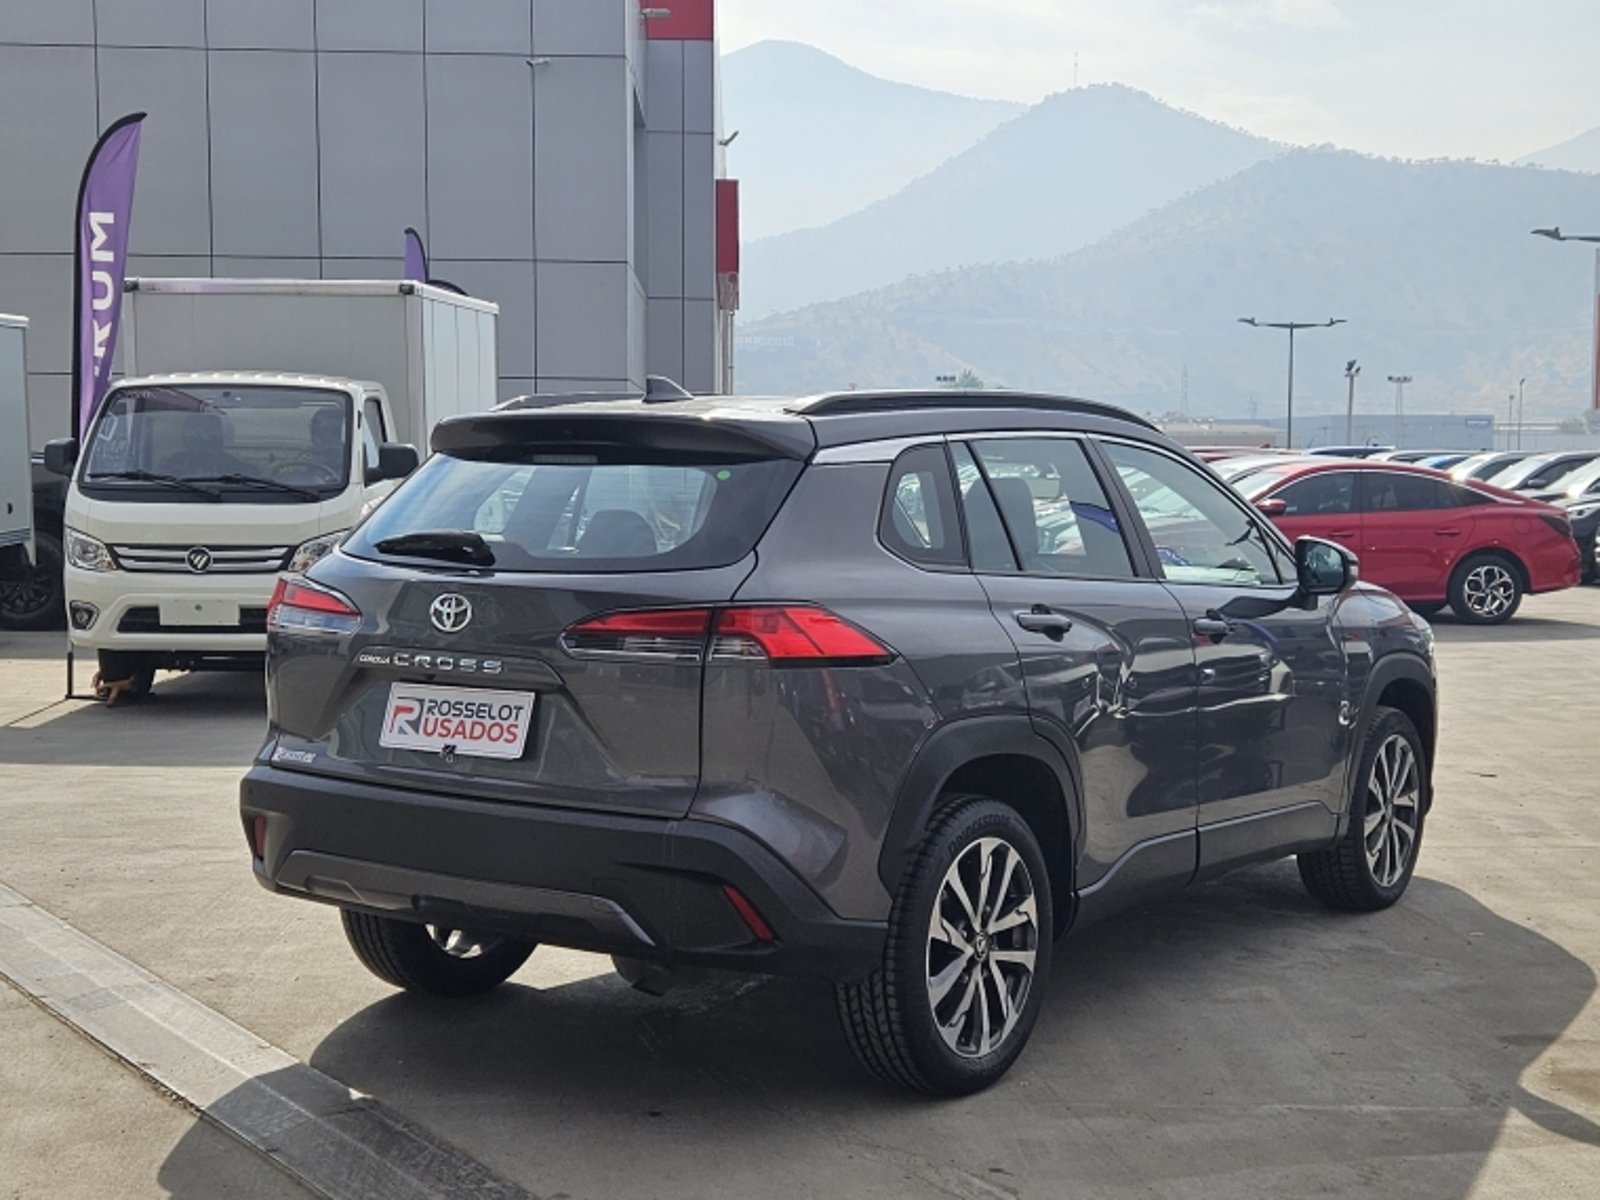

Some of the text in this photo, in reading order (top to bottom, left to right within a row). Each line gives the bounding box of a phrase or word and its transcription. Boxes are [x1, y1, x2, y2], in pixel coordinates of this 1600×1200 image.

[393, 652, 502, 674] CROSS
[425, 699, 524, 721] ROSSELOT
[422, 717, 520, 744] USADOS
